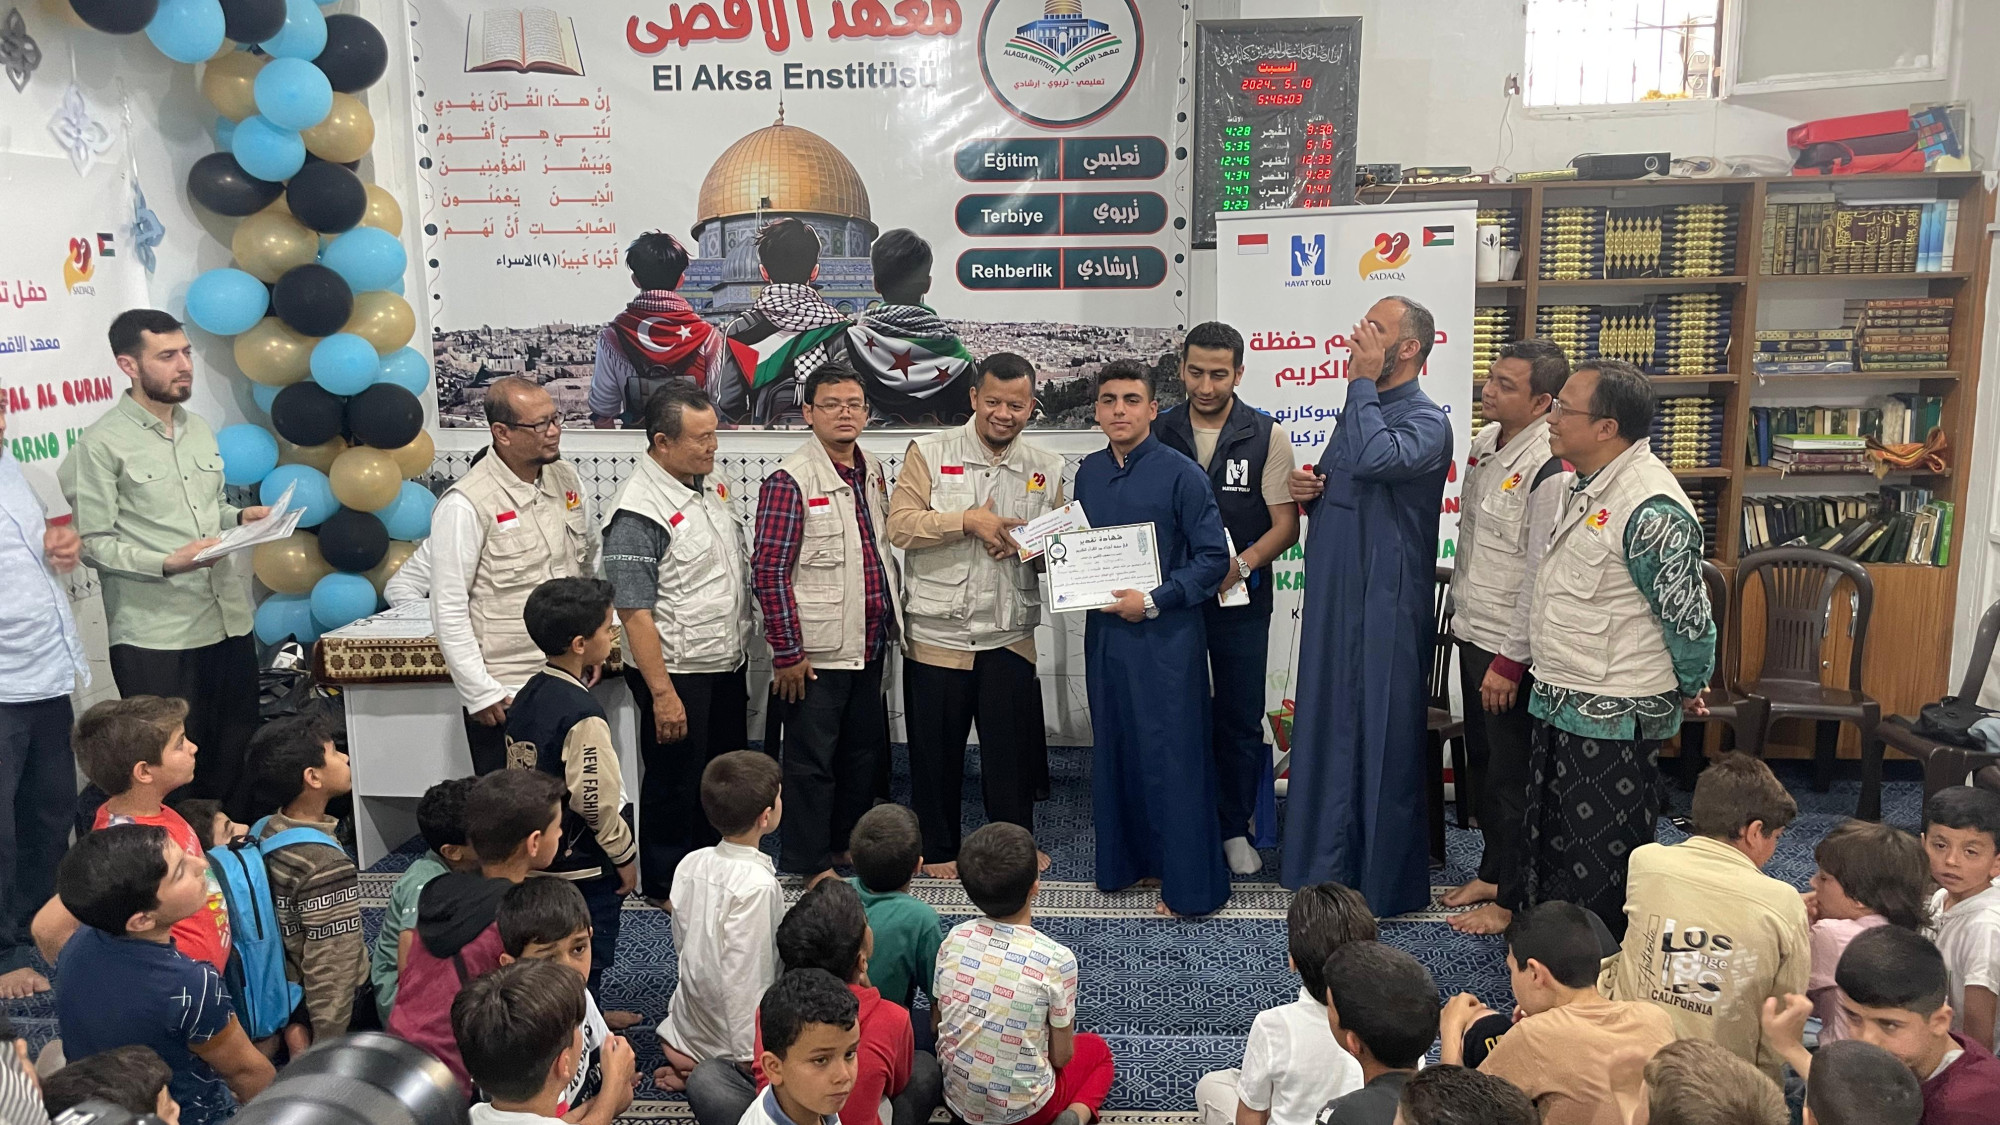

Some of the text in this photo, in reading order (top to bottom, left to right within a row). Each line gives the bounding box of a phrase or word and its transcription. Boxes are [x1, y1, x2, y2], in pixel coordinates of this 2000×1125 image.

[1097, 48, 1120, 59] معهد
[1028, 55, 1057, 74] INSTITUTE
[1258, 61, 1297, 75] السبت
[653, 61, 938, 91] El Aksa Enstitüsü
[1047, 79, 1069, 88] تربوي
[1076, 78, 1105, 88] تعليمي
[1301, 78, 1312, 89] 18
[1258, 93, 1303, 105] 5:46:03
[1225, 126, 1251, 136] 4:28
[1224, 141, 1250, 151] 5:35
[984, 152, 1039, 171] Eğitim
[1083, 144, 1140, 175] تعليمي
[1220, 156, 1250, 166] 12:45
[1224, 171, 1249, 180] 4:34
[1225, 185, 1249, 195] 7:47
[1306, 185, 1331, 194] 7:41
[1093, 198, 1140, 224] تربوي
[1223, 200, 1249, 210] 9:23
[981, 208, 1043, 226] Terbiye
[972, 263, 1052, 279] Rehberlik
[1369, 272, 1406, 281] SADAQA
[1284, 279, 1331, 288] HAYAT YOLU
[13, 280, 47, 308] حفل
[30, 337, 60, 351] معهد
[1250, 331, 1316, 351] حفظة
[1275, 359, 1348, 387] الكريم
[37, 382, 58, 410] AL
[63, 376, 113, 406] QURAN
[1291, 430, 1325, 447] تركيا
[989, 938, 1009, 949] MARVEL
[1661, 918, 1733, 957] LOS
[961, 956, 980, 969] MARVEL
[1005, 952, 1026, 964] MARVEL
[1023, 966, 1043, 980] MARVEL
[994, 985, 1014, 998] MARVEL
[1651, 989, 1713, 1016] CALIFORNIA
[975, 1051, 994, 1063] MARVEL
